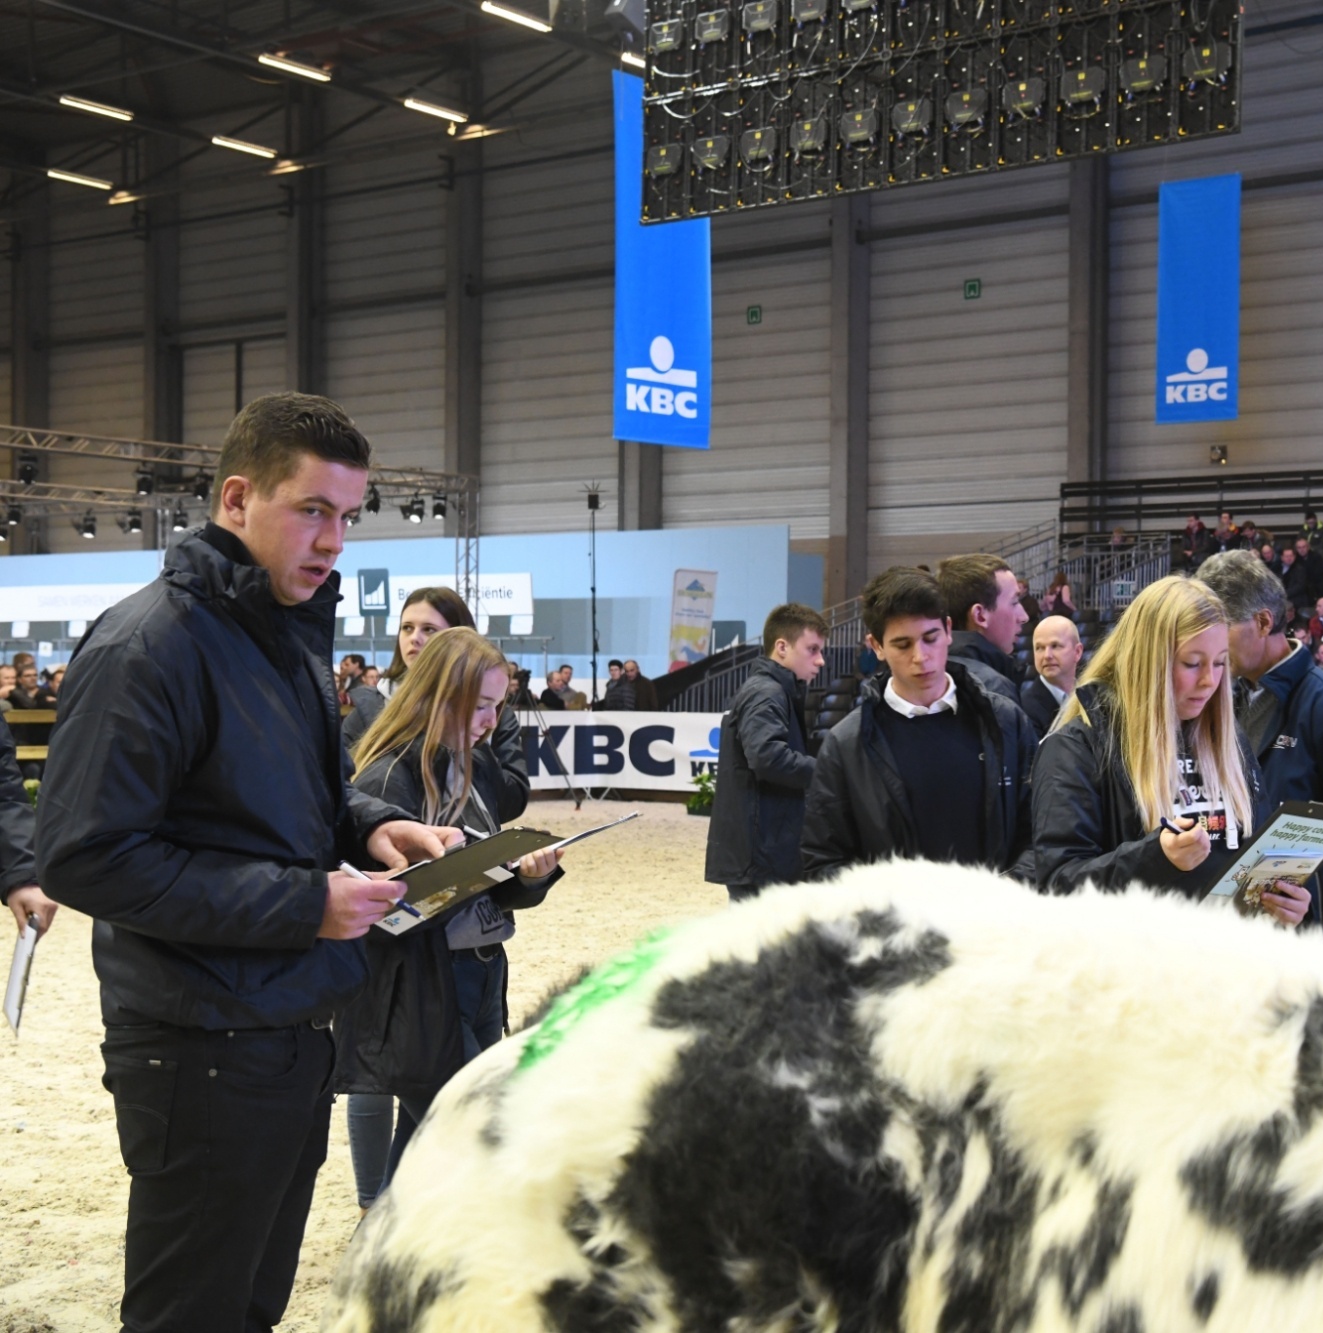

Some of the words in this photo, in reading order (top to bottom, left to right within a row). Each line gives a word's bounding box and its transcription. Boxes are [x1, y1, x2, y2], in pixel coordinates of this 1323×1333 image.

[625, 383, 698, 419] KBC
[1166, 381, 1228, 404] KBC
[521, 725, 675, 777] KBC
[1270, 829, 1300, 841] happy
[1282, 821, 1313, 833] Happy
